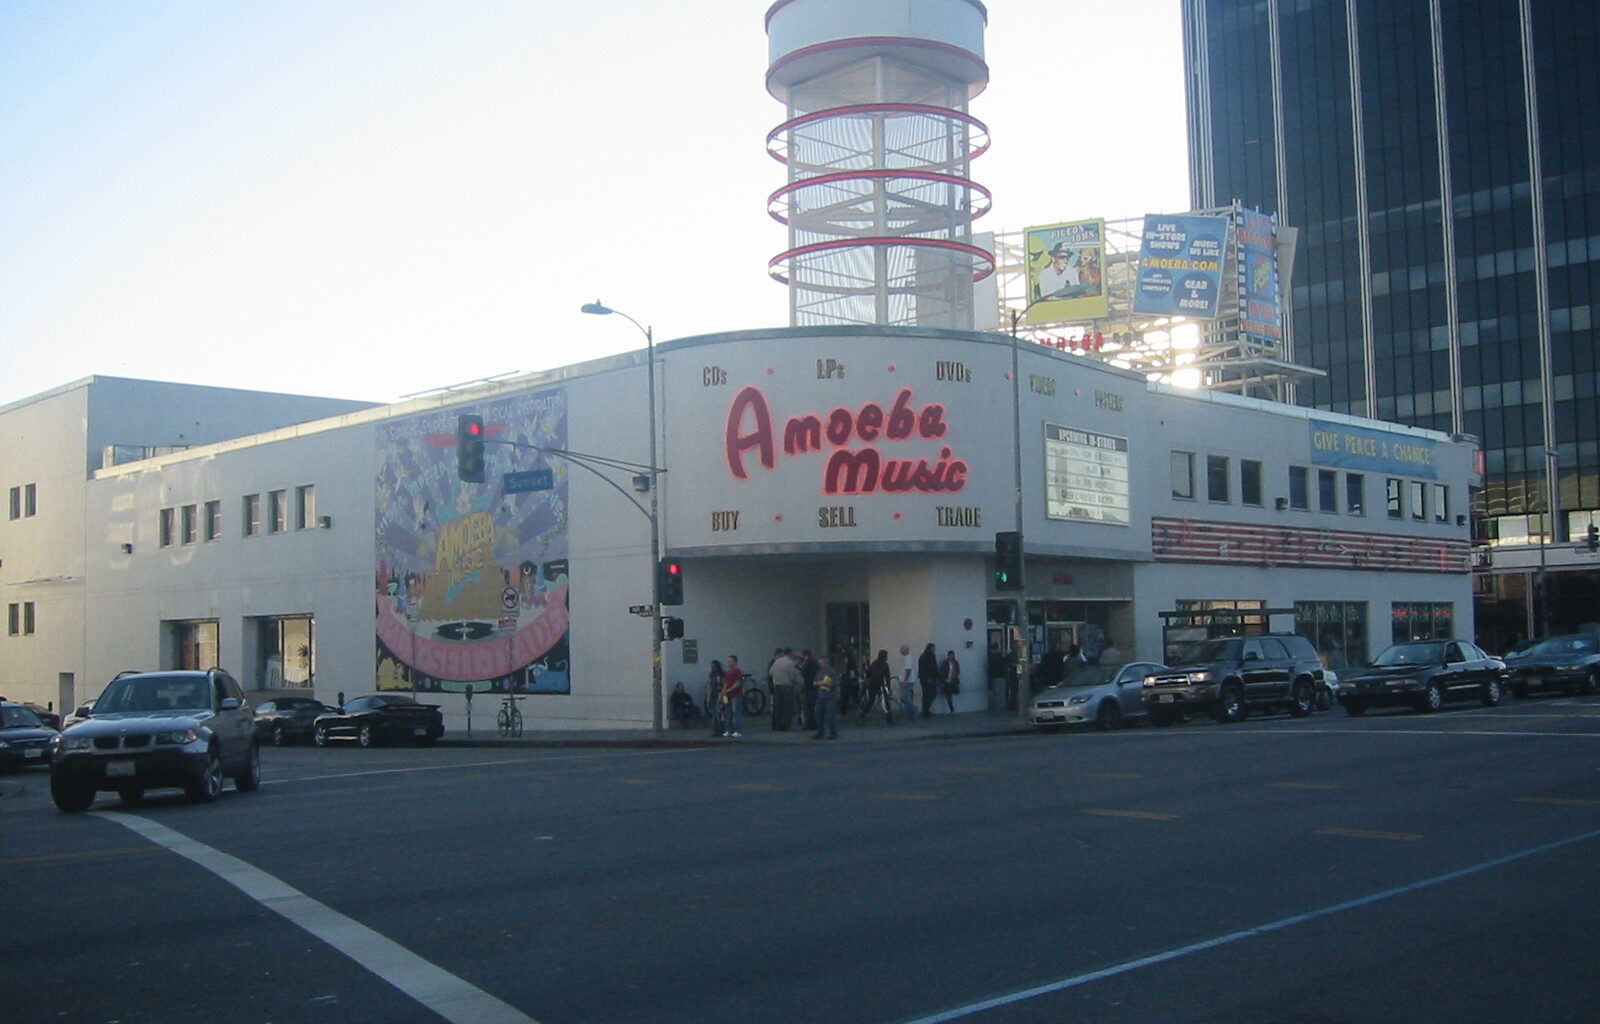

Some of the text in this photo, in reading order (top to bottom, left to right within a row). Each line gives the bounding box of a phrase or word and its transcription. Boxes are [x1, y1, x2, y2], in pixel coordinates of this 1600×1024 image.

[1051, 225, 1085, 240] PIGEON
[1157, 224, 1177, 232] LIVE
[1072, 230, 1095, 242] JOHN
[1145, 232, 1187, 242] IN-STORE
[1150, 241, 1180, 250] SHOWS
[1193, 240, 1219, 248] MUSIC
[1189, 248, 1220, 257] WE LIKE
[1142, 258, 1219, 272] AMOEBA.COM
[1185, 280, 1208, 290] GEAR
[1190, 290, 1199, 298] &
[1179, 299, 1209, 309] MORE!
[703, 365, 727, 387] CDs
[816, 359, 845, 380] LPs
[936, 361, 972, 382] DVDs
[726, 385, 948, 480] Amoeba
[1314, 430, 1339, 451] GIVE
[1345, 433, 1377, 457] PEACE
[1382, 441, 1390, 458] A
[823, 446, 968, 495] Music
[510, 475, 548, 489] Sunset
[711, 511, 739, 531] BUY
[818, 506, 857, 527] SELL
[936, 506, 981, 527] TRADE
